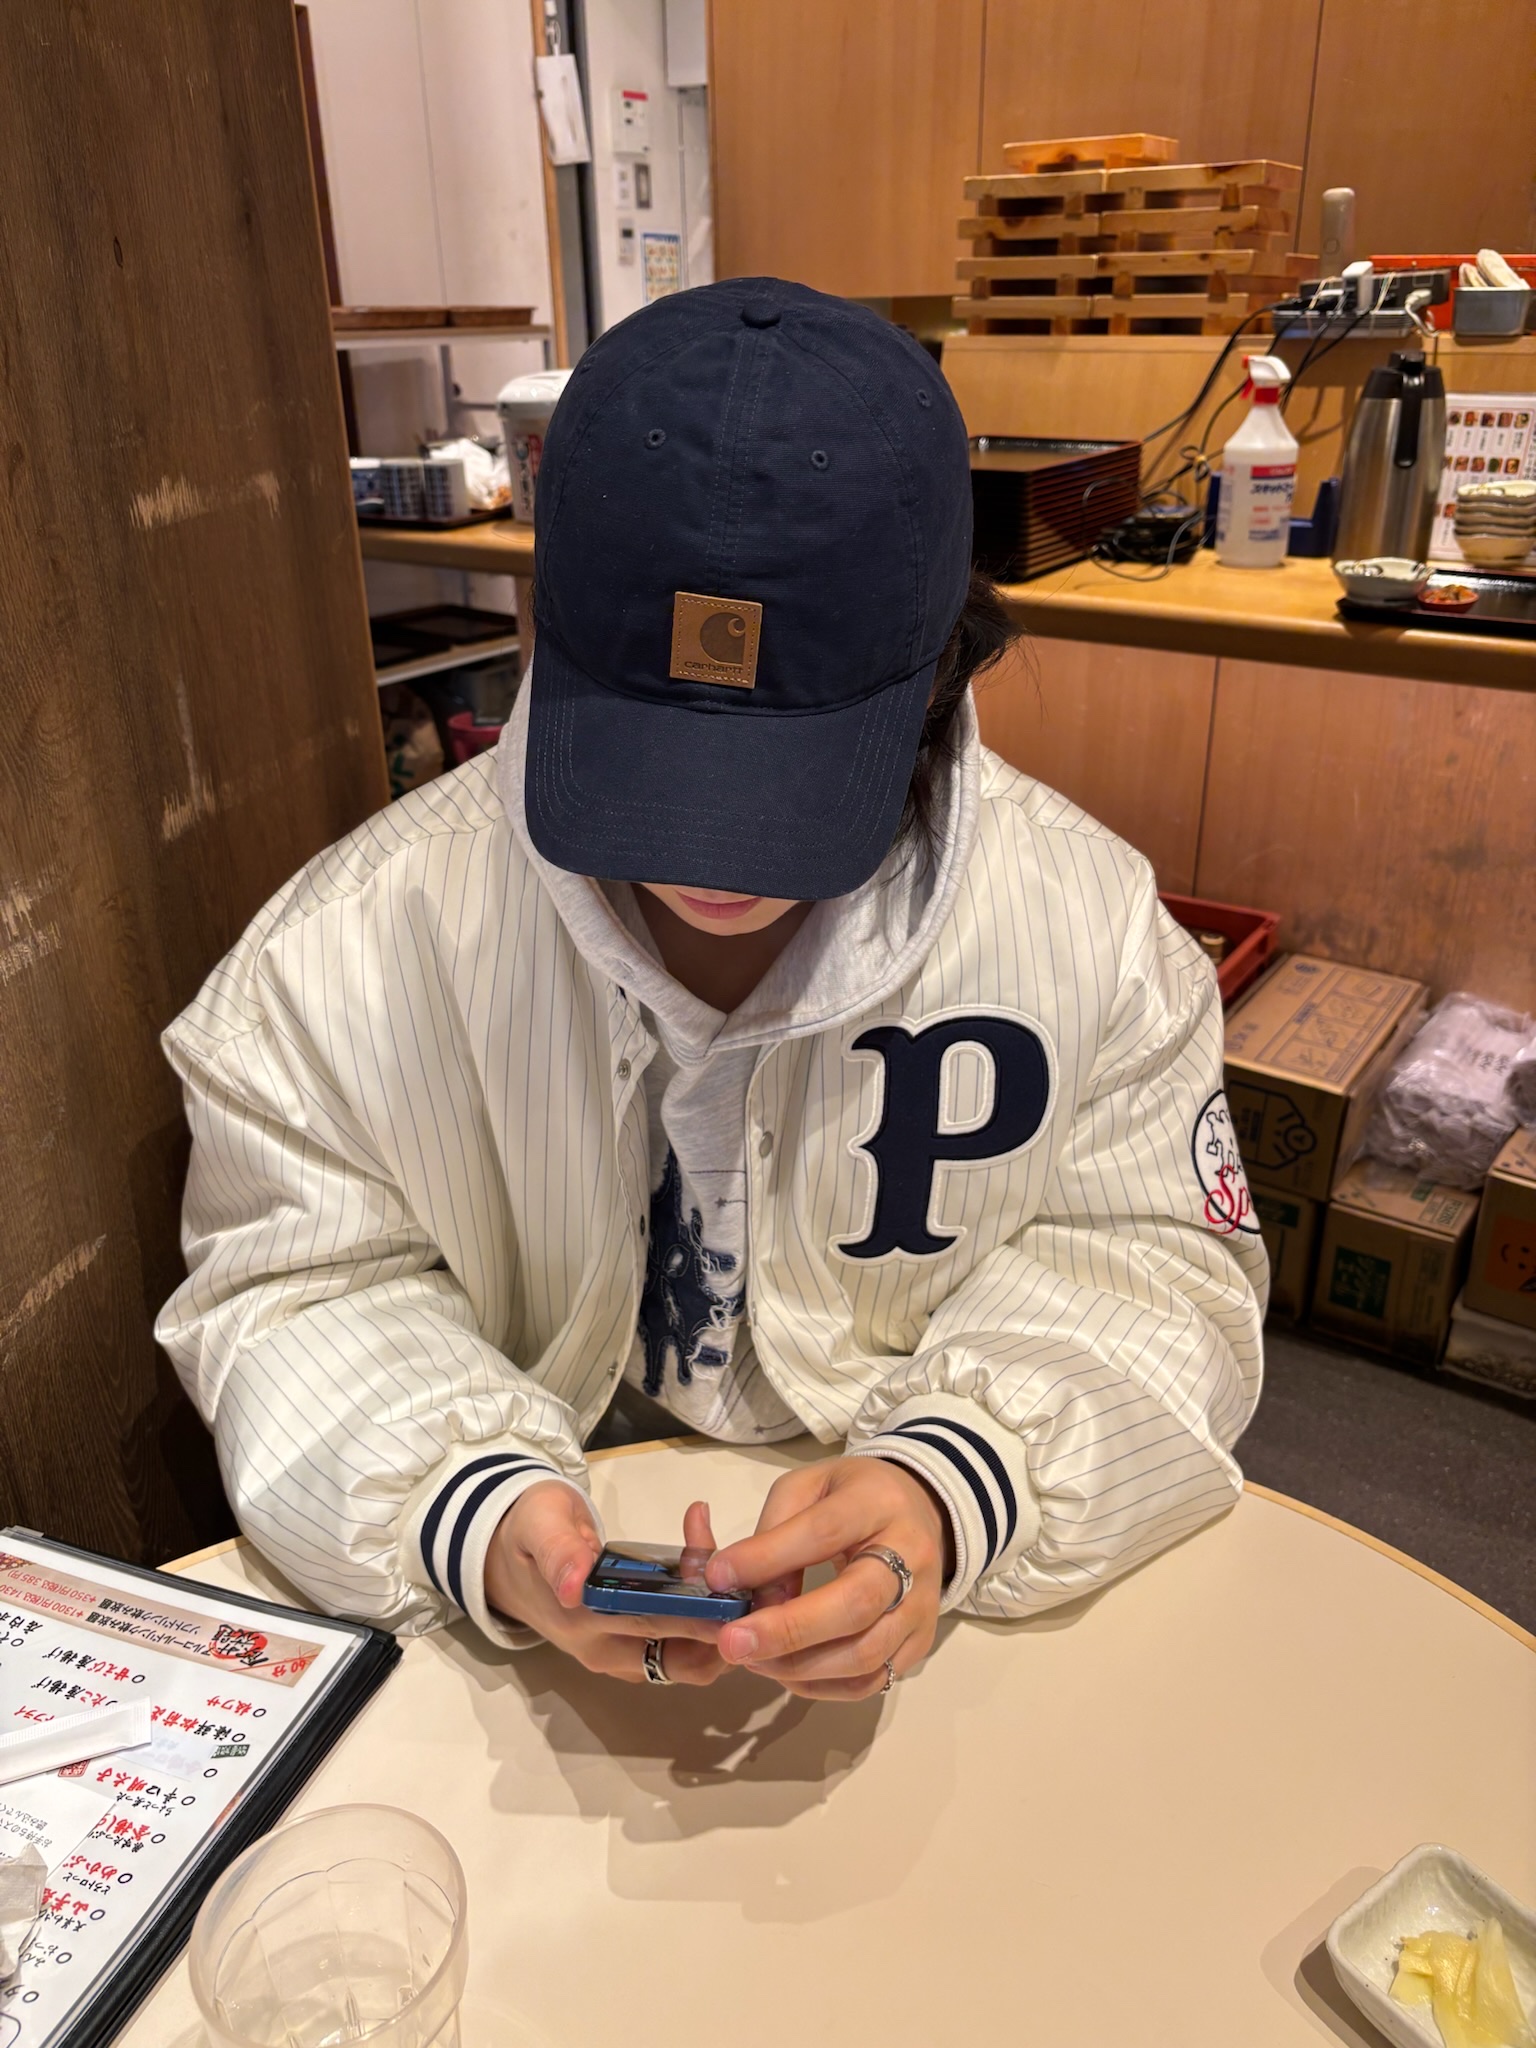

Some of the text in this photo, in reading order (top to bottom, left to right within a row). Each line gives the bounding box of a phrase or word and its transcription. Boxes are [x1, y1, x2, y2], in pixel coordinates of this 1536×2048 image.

[683, 660, 744, 675] carhartt
[836, 1014, 1051, 1261] P
[96, 1768, 178, 1804] 辛口明太子
[63, 1855, 118, 1881] めかぶ
